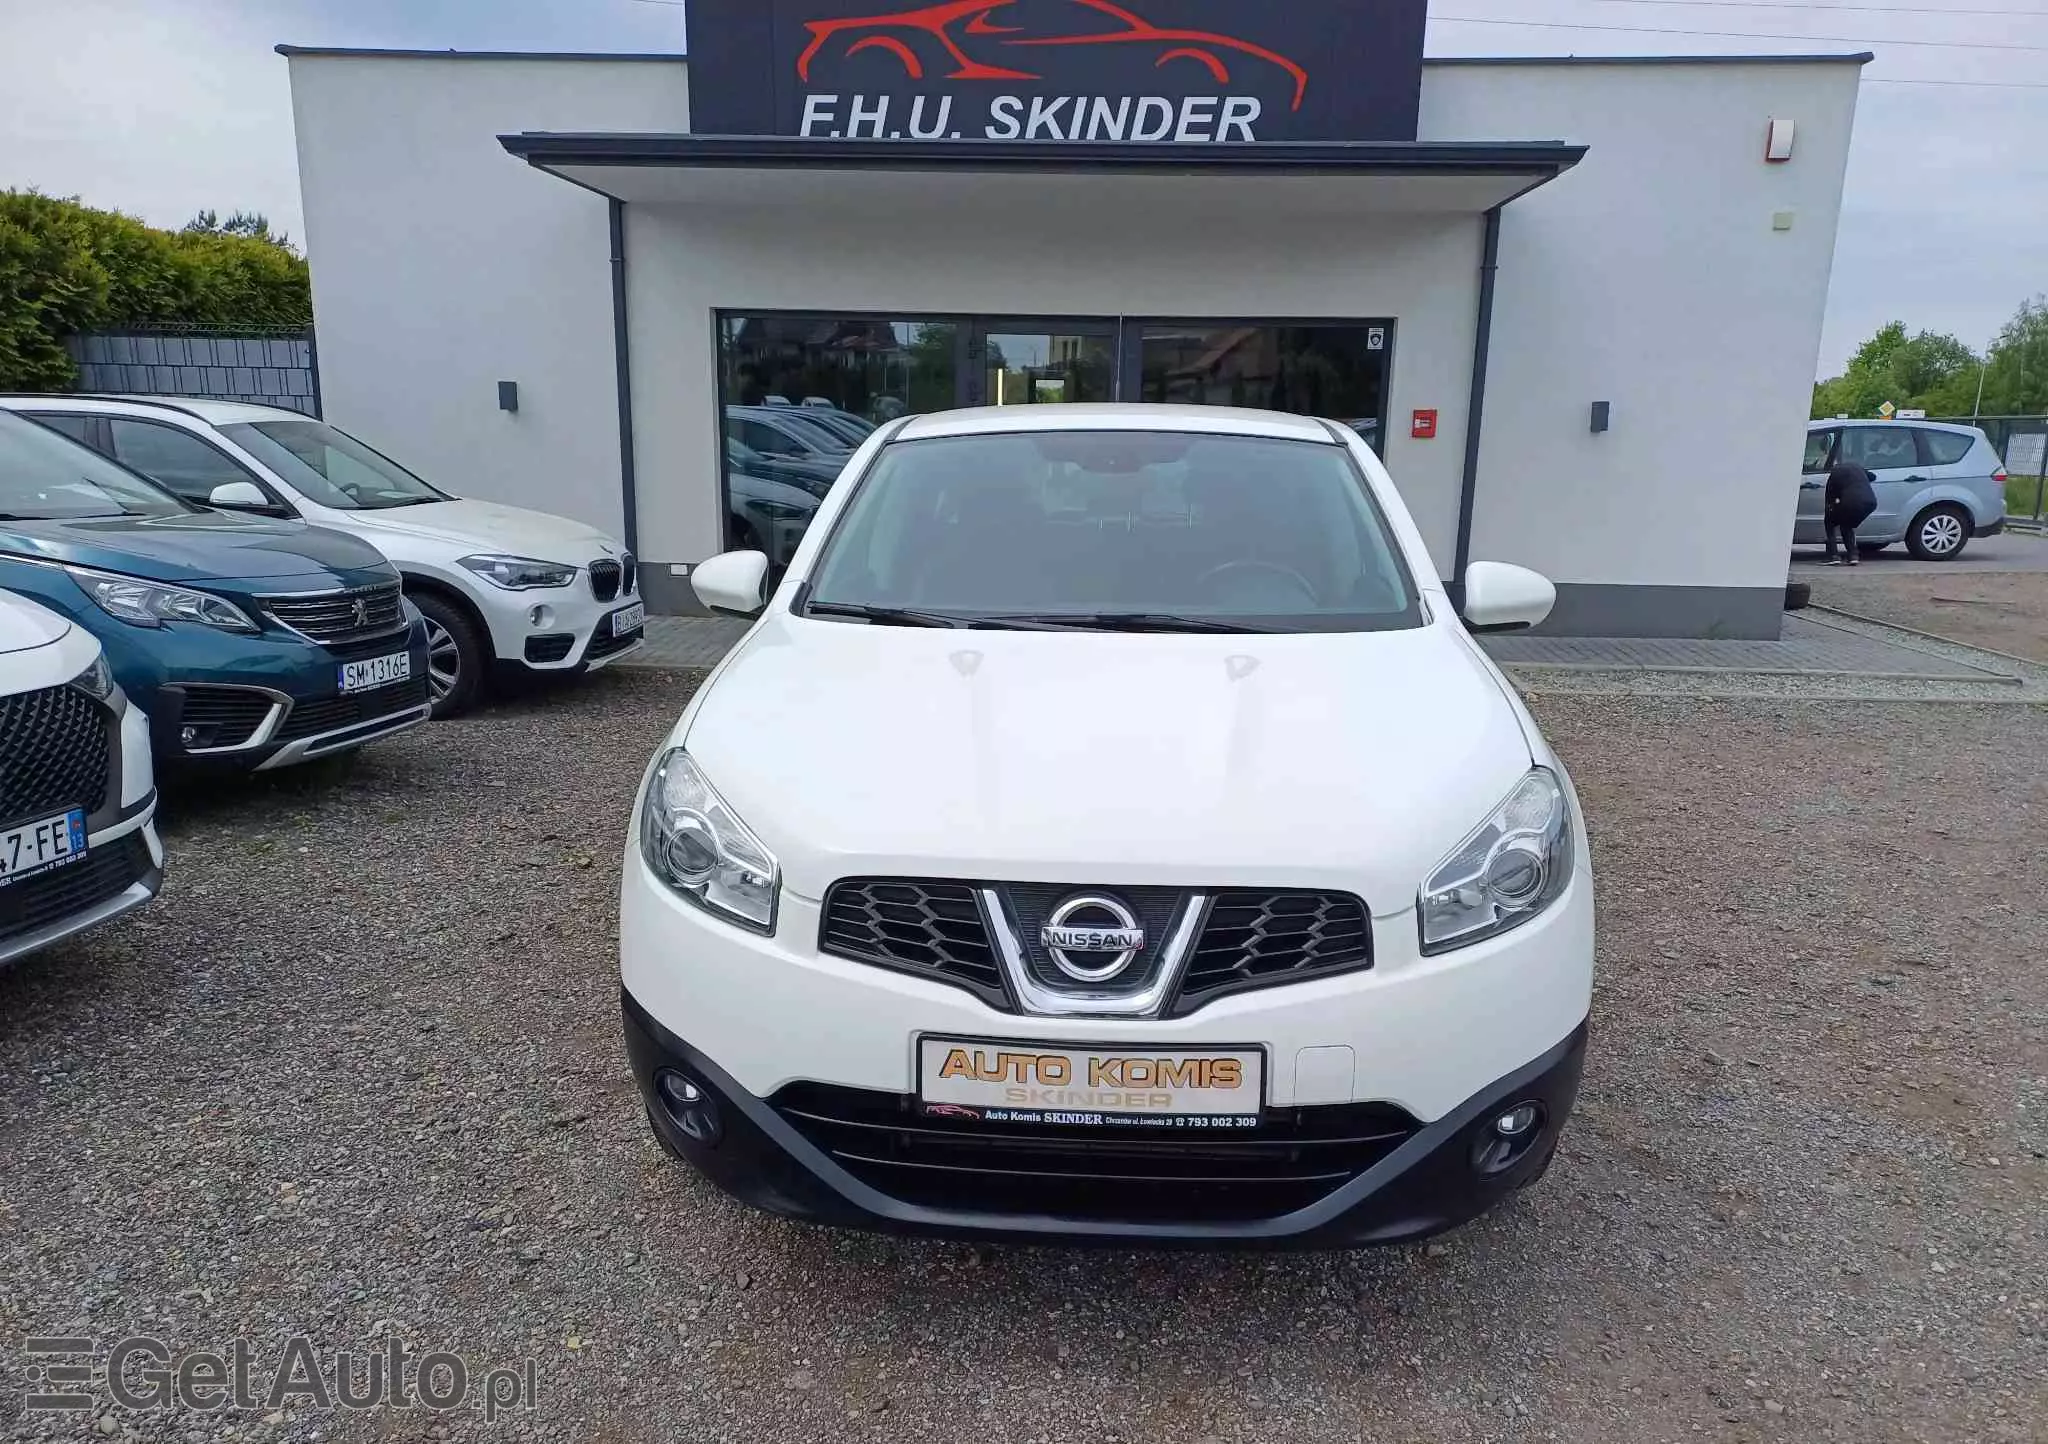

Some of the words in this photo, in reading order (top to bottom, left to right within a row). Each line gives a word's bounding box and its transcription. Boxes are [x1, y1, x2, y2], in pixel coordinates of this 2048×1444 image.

[800, 95, 961, 139] F.H.U.
[985, 95, 1262, 142] SKINDER
[346, 664, 365, 687] SM
[371, 654, 407, 680] 1316E
[1052, 932, 1132, 946] NISSAN
[939, 1049, 1071, 1086] AUTO
[1088, 1056, 1242, 1088] KOMIS
[1005, 1087, 1172, 1108] SKINDER
[985, 1110, 1008, 1121] Auto
[1010, 1111, 1041, 1122] Komis
[1044, 1112, 1103, 1125] SKINDER
[1187, 1117, 1209, 1127] 793
[1211, 1118, 1232, 1127] 002
[1235, 1118, 1257, 1127] 309
